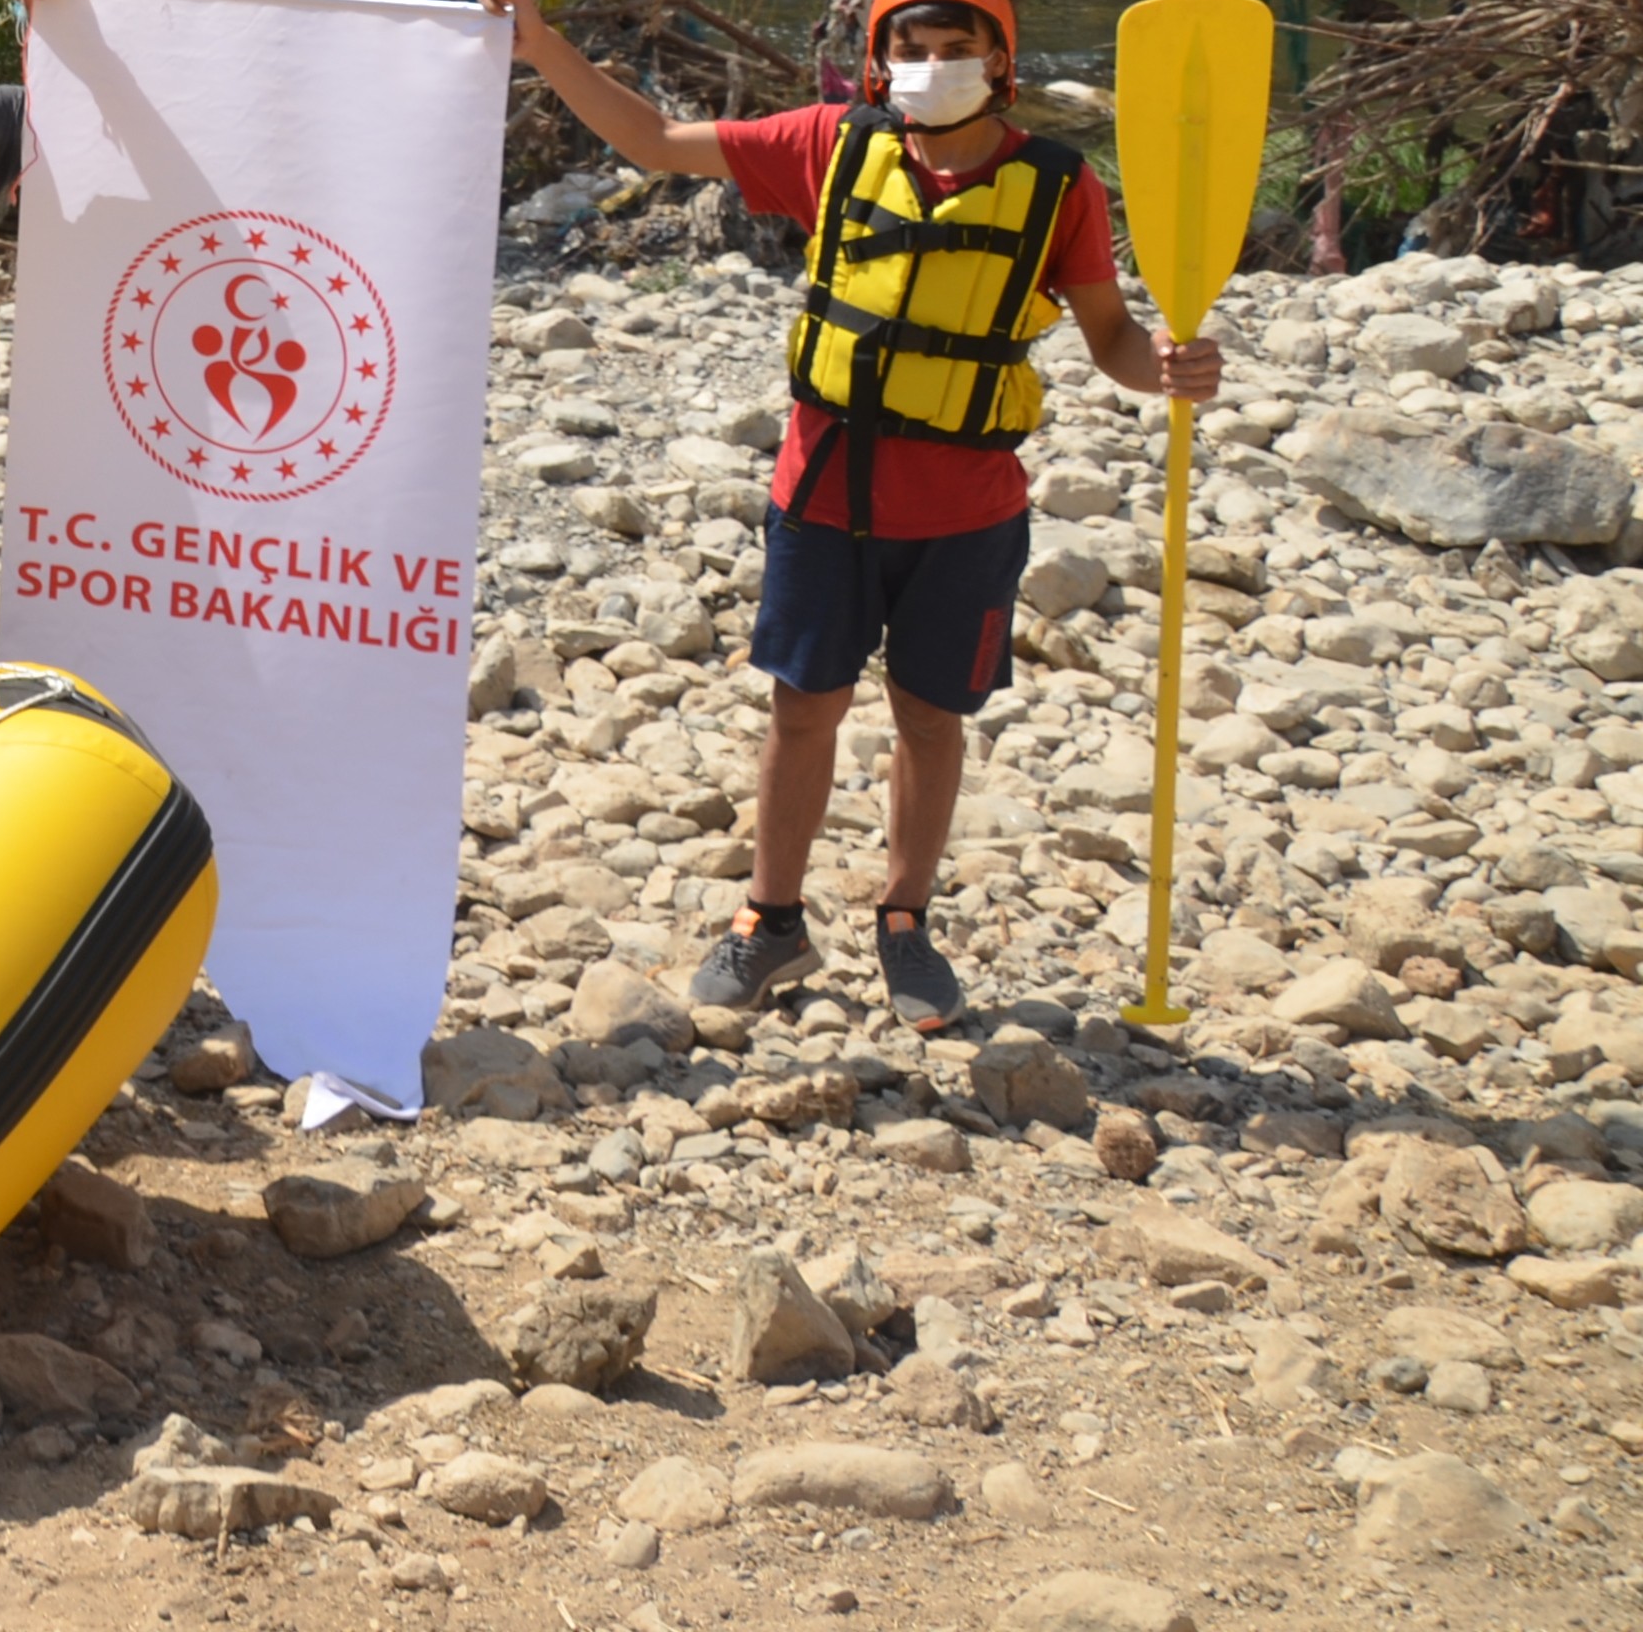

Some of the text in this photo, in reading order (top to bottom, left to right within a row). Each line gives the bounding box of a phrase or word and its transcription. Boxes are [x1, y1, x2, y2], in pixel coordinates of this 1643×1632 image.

[19, 506, 461, 599] T.C. GENÇLİK VE
[16, 561, 459, 656] SPOR BAKANLIĞI
